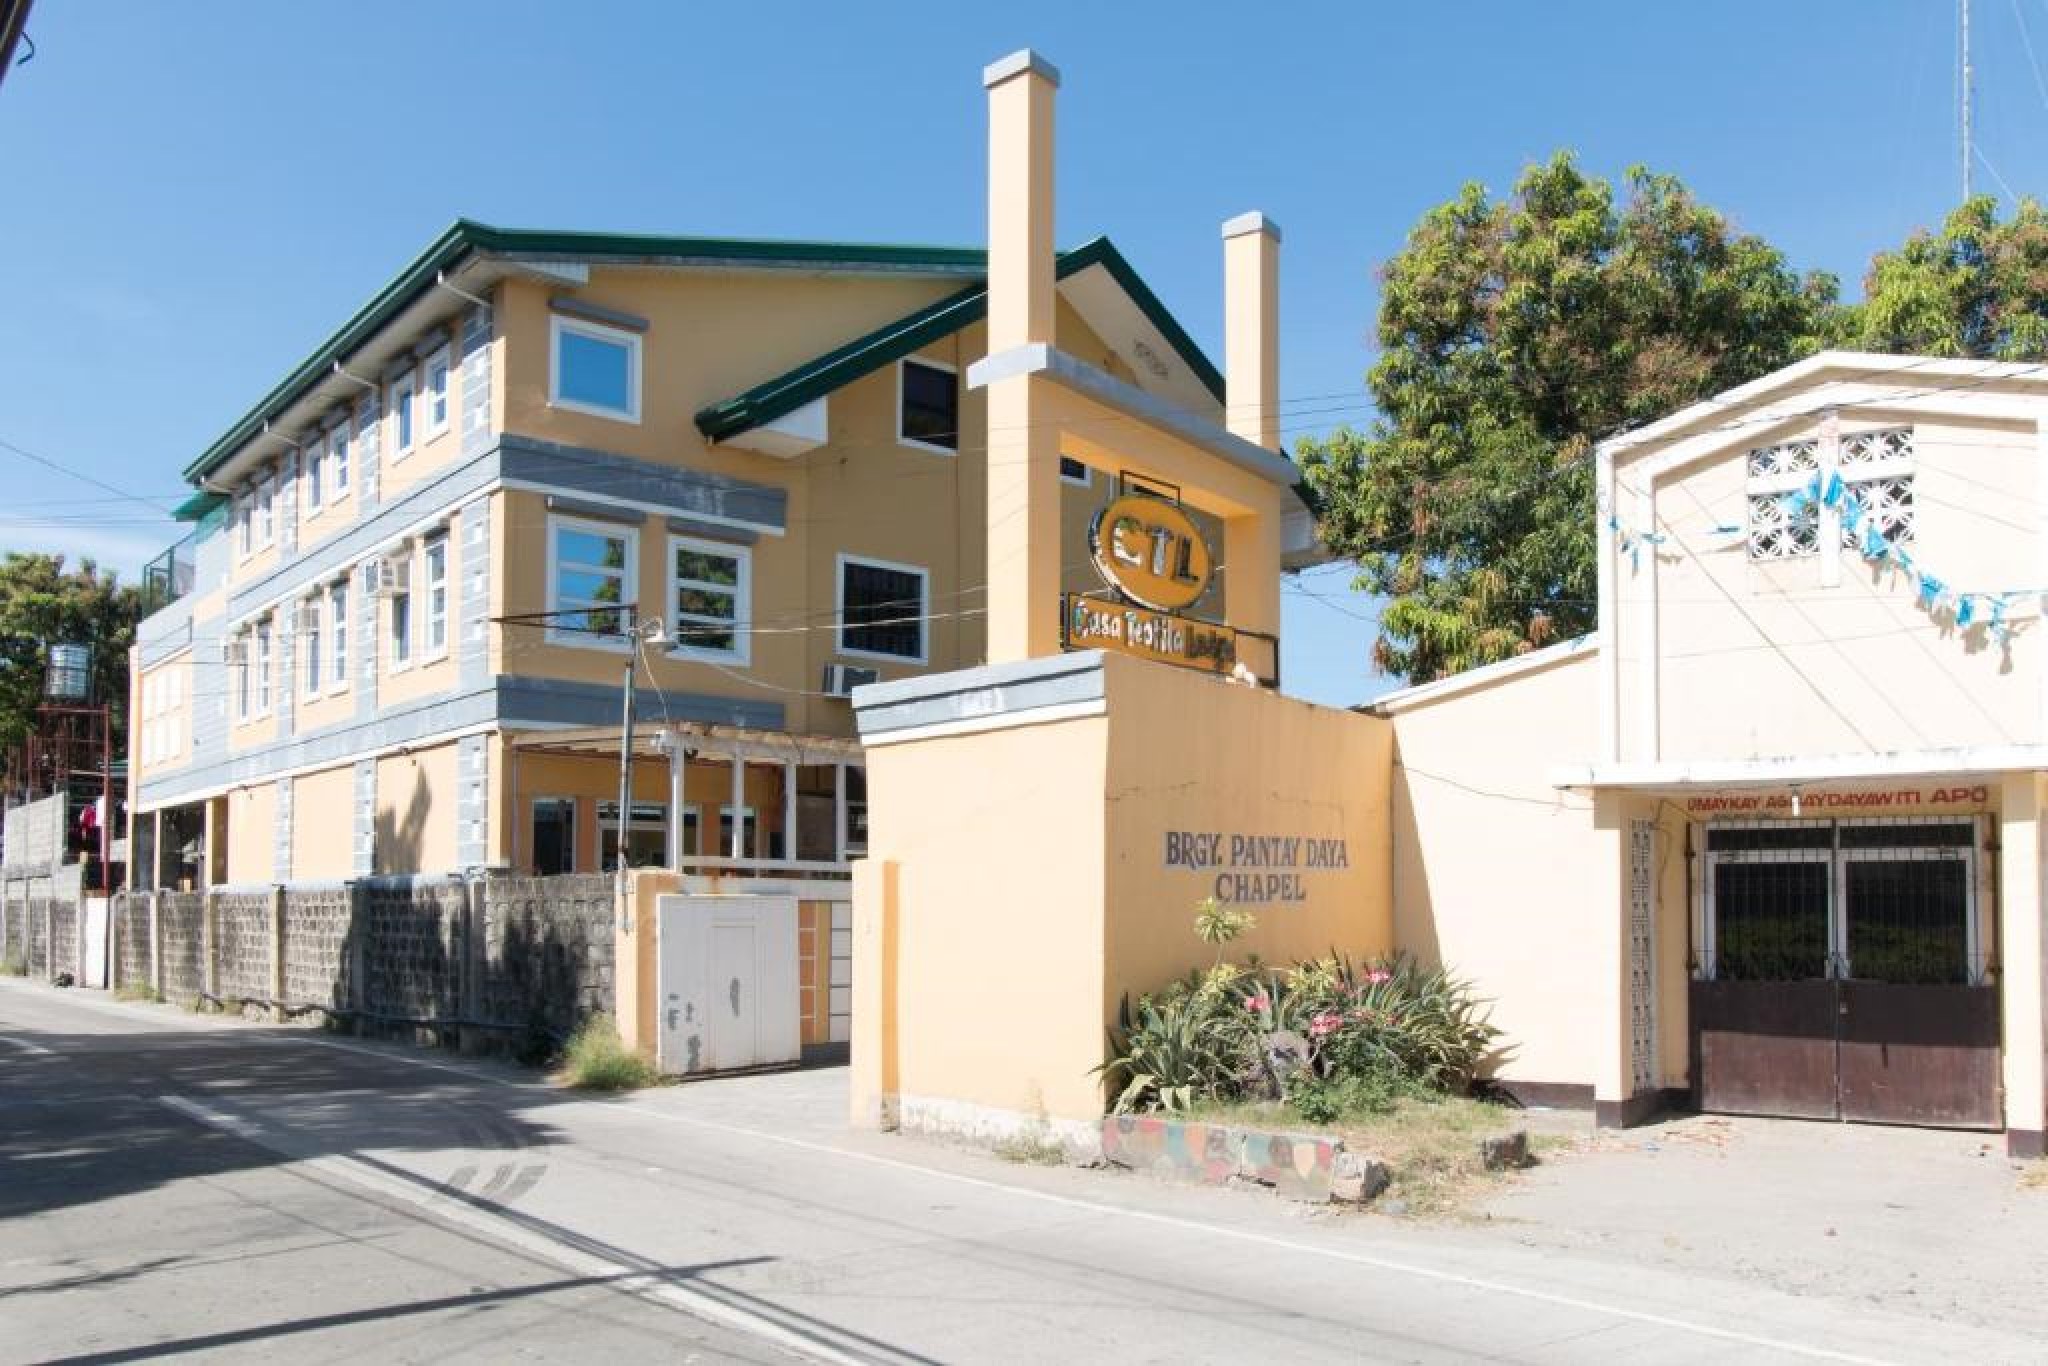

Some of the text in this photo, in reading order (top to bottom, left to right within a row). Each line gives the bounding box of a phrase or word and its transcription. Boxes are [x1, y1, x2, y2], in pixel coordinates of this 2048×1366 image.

[1112, 516, 1199, 582] CTL
[1072, 600, 1122, 639] Casa
[1930, 785, 1989, 804] APO
[1165, 831, 1349, 869] BRGY. PANTAY DAYA
[1215, 873, 1307, 903] CHAPEL
